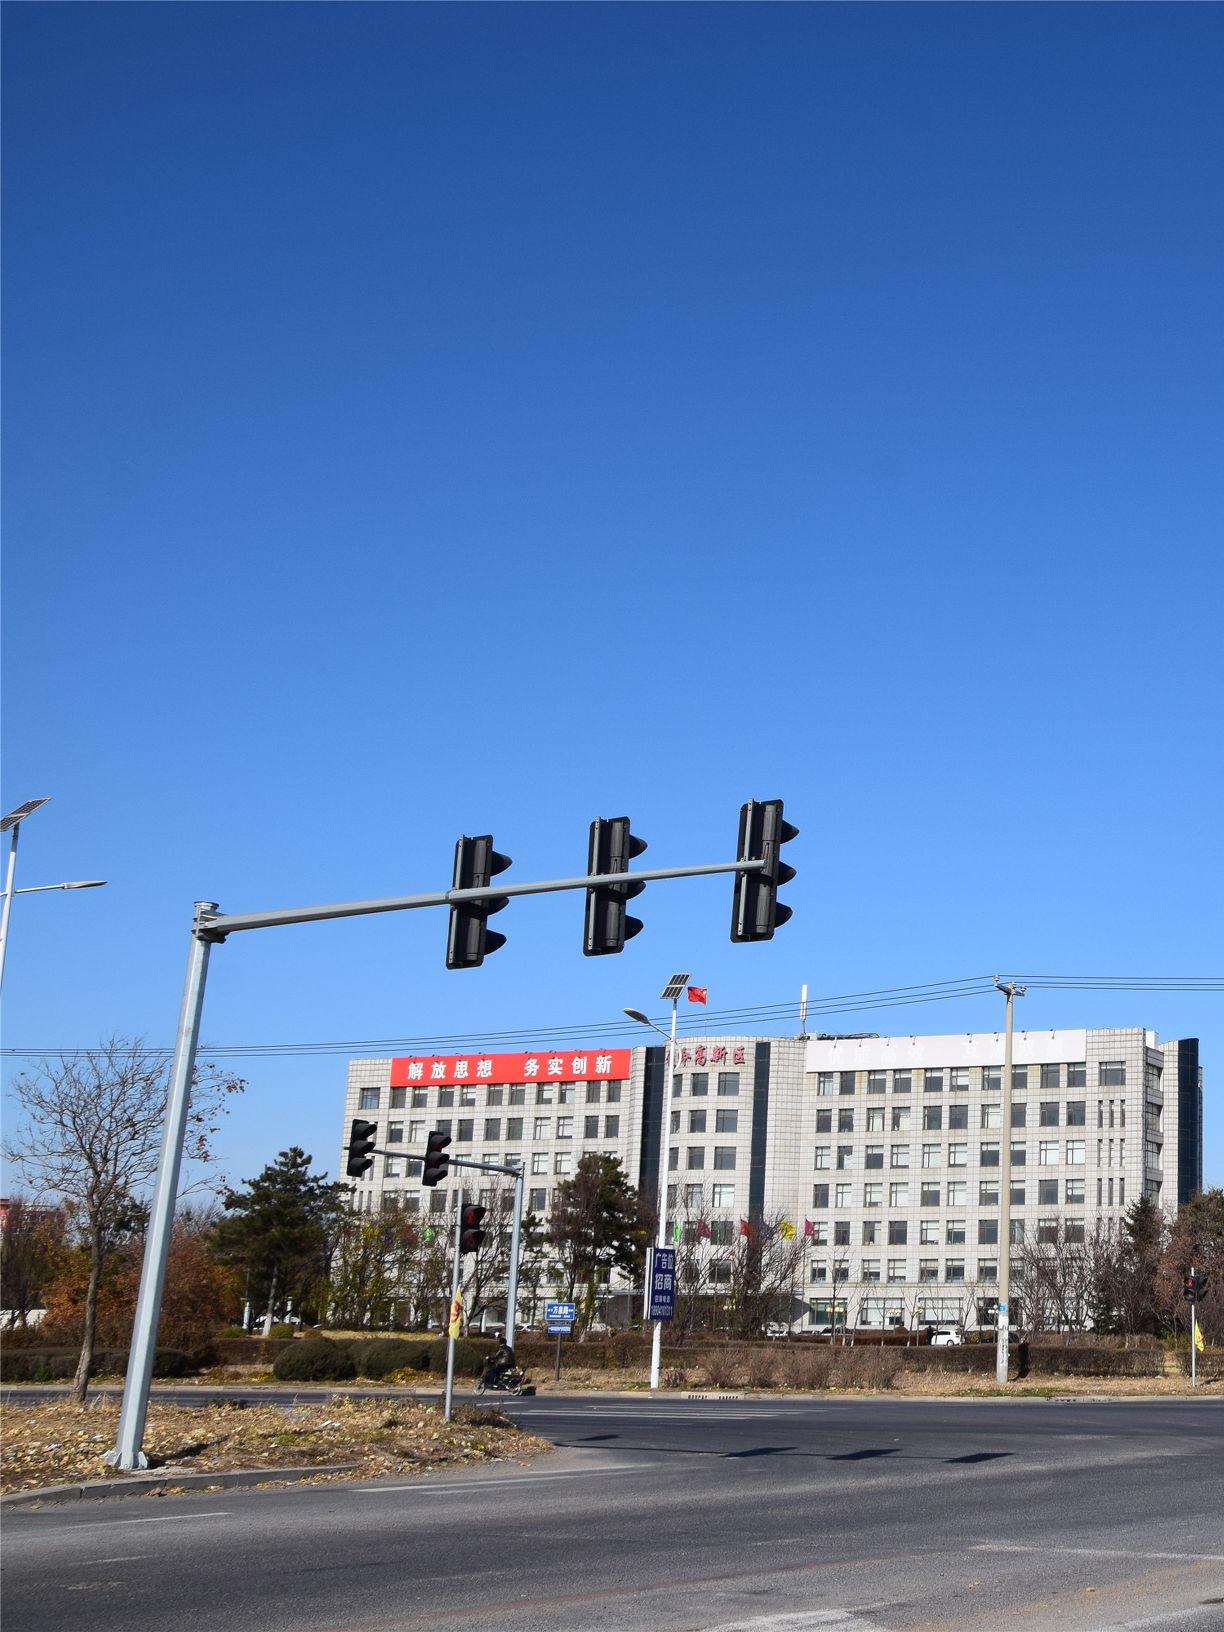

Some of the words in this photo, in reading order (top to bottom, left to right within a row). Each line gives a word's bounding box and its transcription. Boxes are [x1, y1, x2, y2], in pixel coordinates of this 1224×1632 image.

[408, 1060, 493, 1080] 解放思想
[524, 1055, 613, 1077] 务实创新
[655, 1253, 673, 1269] 广告位
[655, 1274, 672, 1290] 招商
